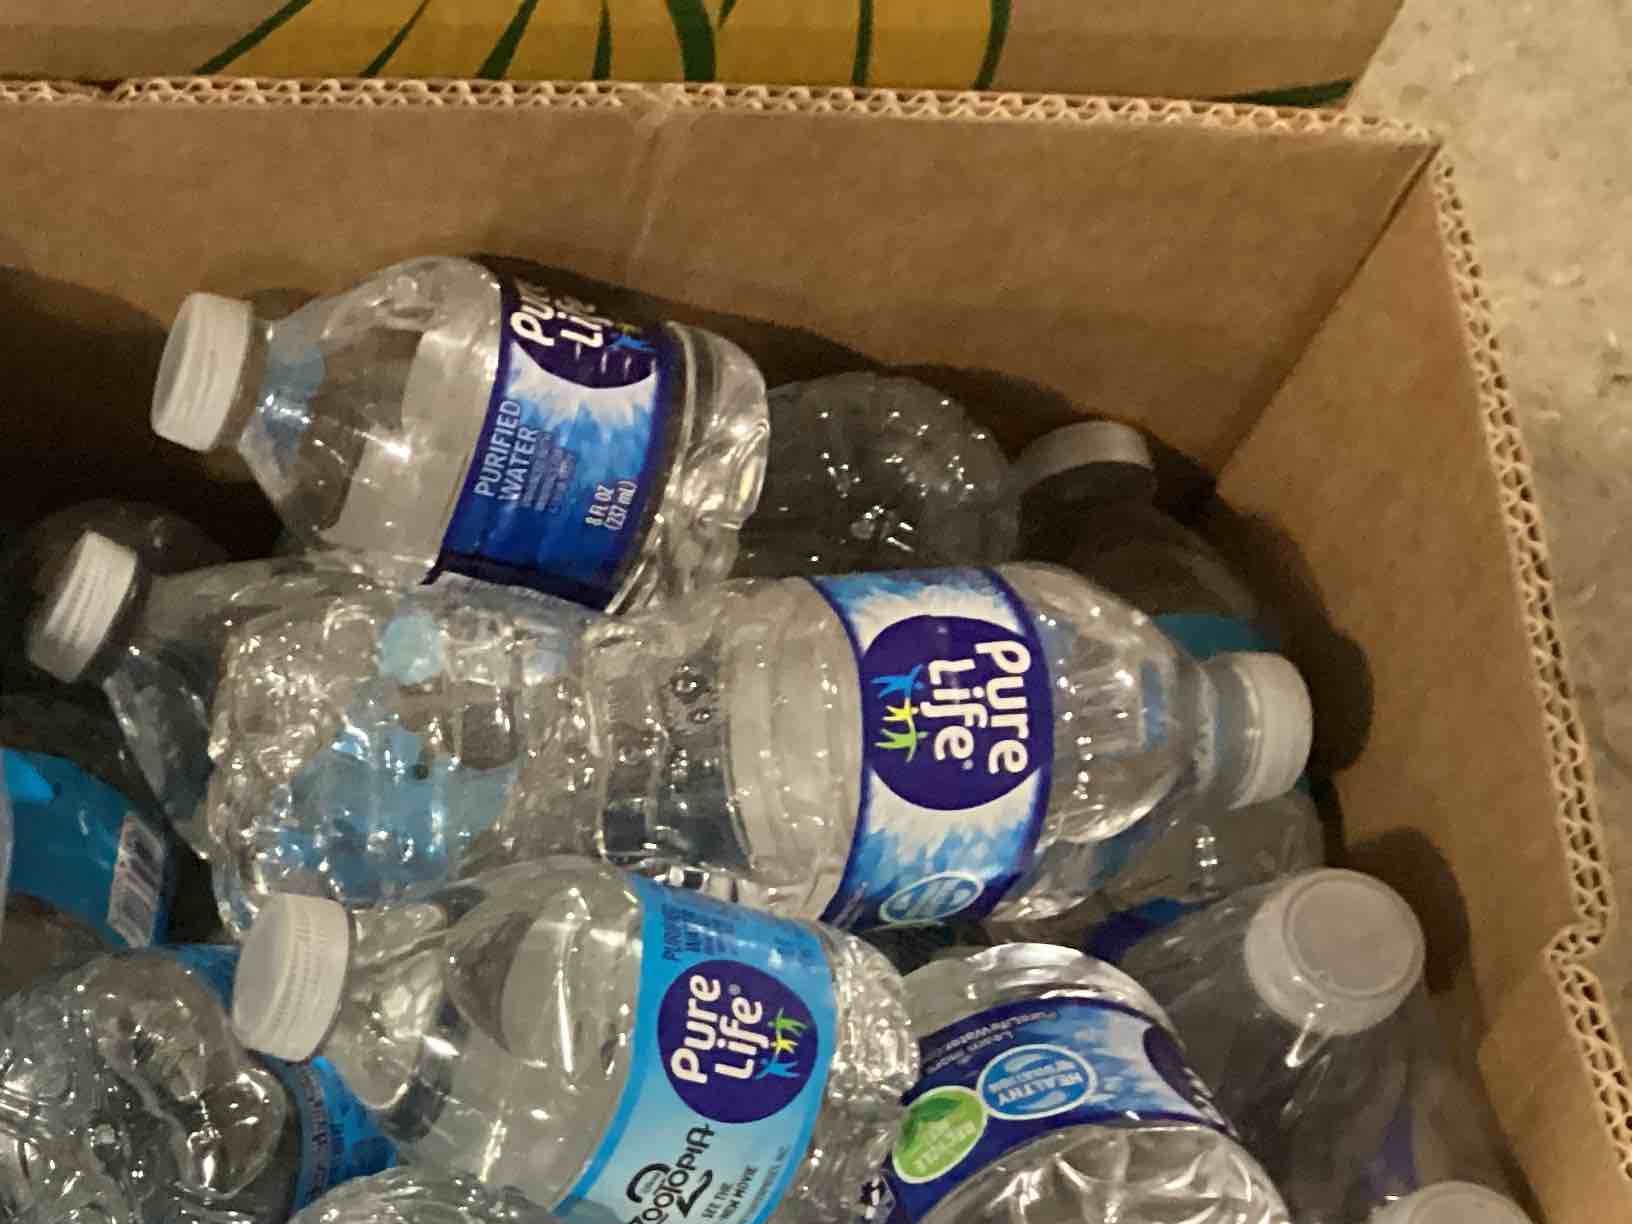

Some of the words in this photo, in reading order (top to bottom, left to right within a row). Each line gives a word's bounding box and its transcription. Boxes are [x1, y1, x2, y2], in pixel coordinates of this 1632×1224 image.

[474, 399, 521, 497] PURIFIED
[499, 427, 540, 502] WATER
[918, 658, 988, 760] Life
[974, 639, 1032, 774] Pure
[669, 973, 724, 1084] Pure
[712, 994, 770, 1081] Life
